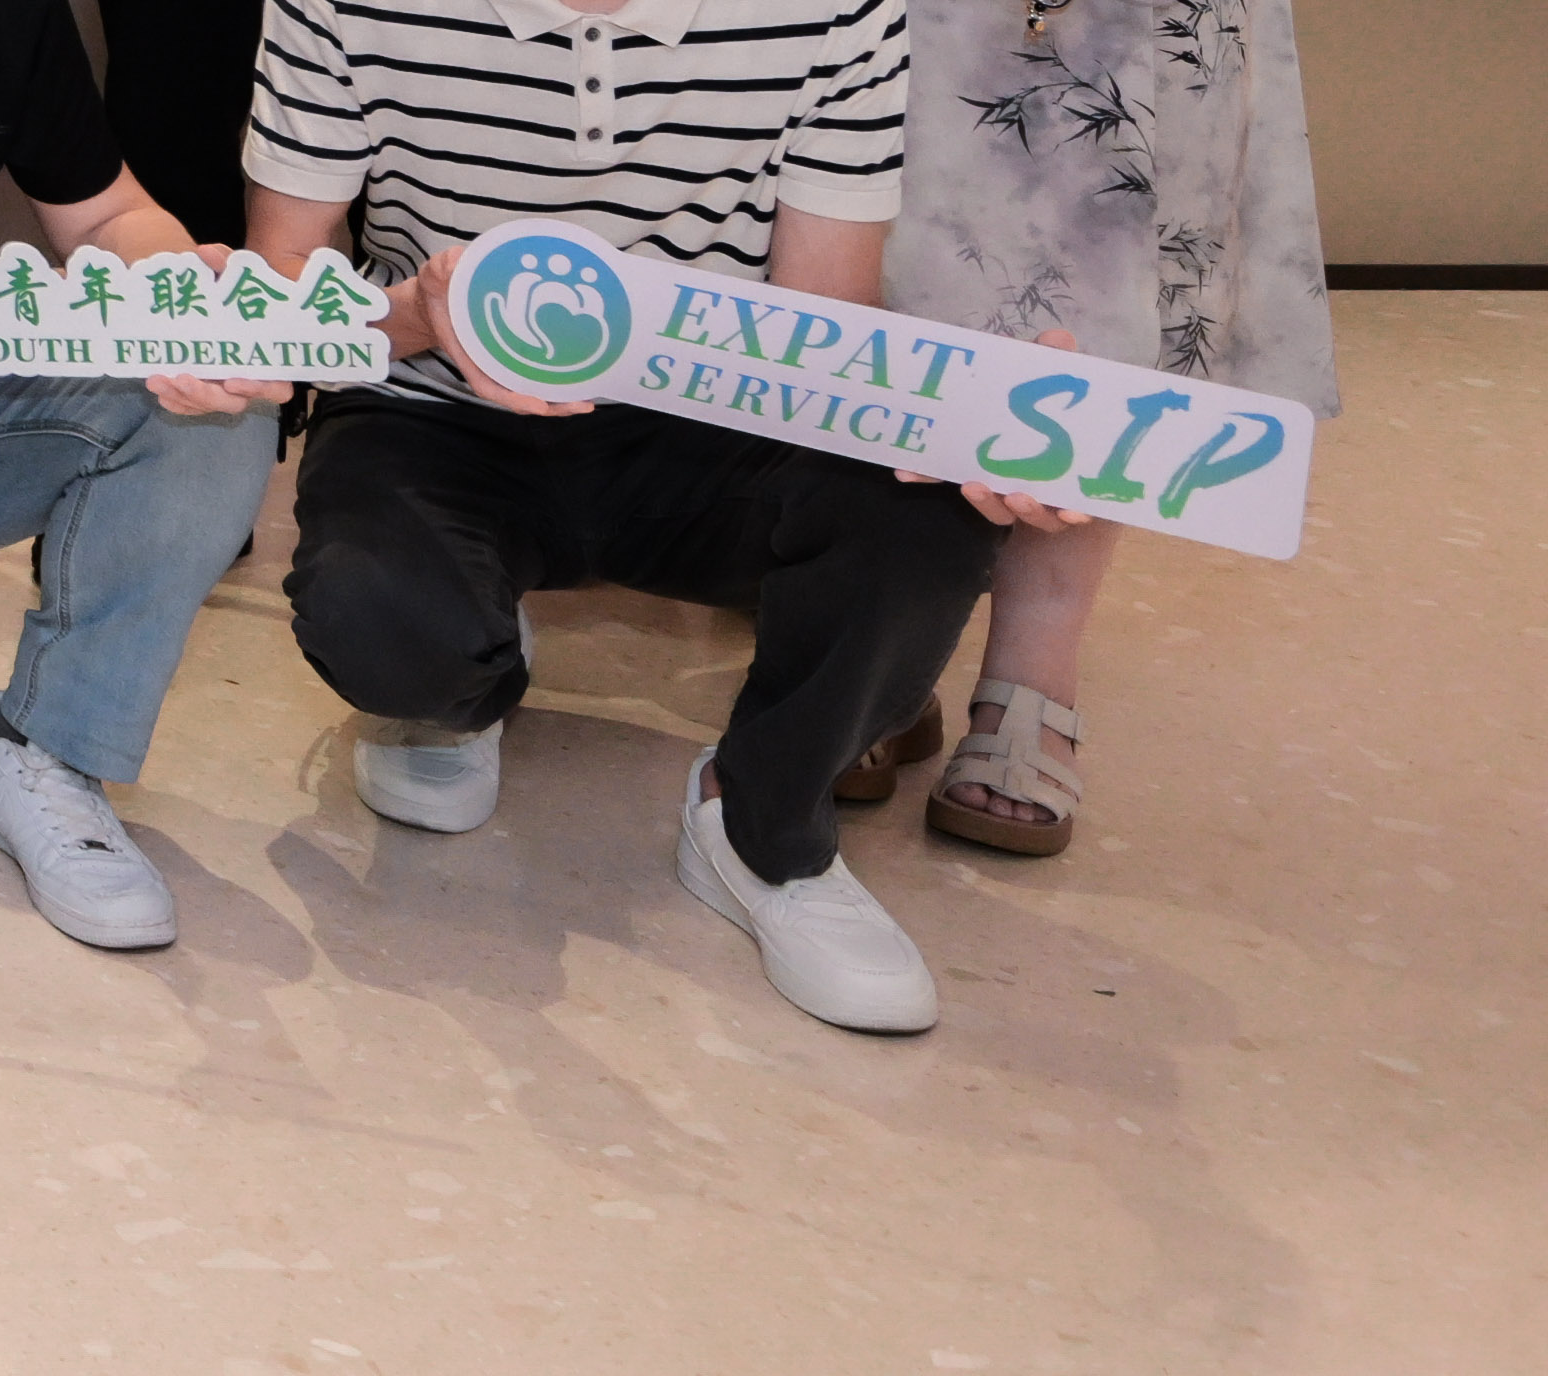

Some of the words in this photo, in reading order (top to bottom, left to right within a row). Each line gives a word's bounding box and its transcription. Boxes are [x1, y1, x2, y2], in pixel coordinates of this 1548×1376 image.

[114, 339, 374, 370] FEDERATION
[655, 283, 976, 403] EXPAT
[639, 353, 935, 454] SERVICE
[976, 373, 1286, 519] SIP
